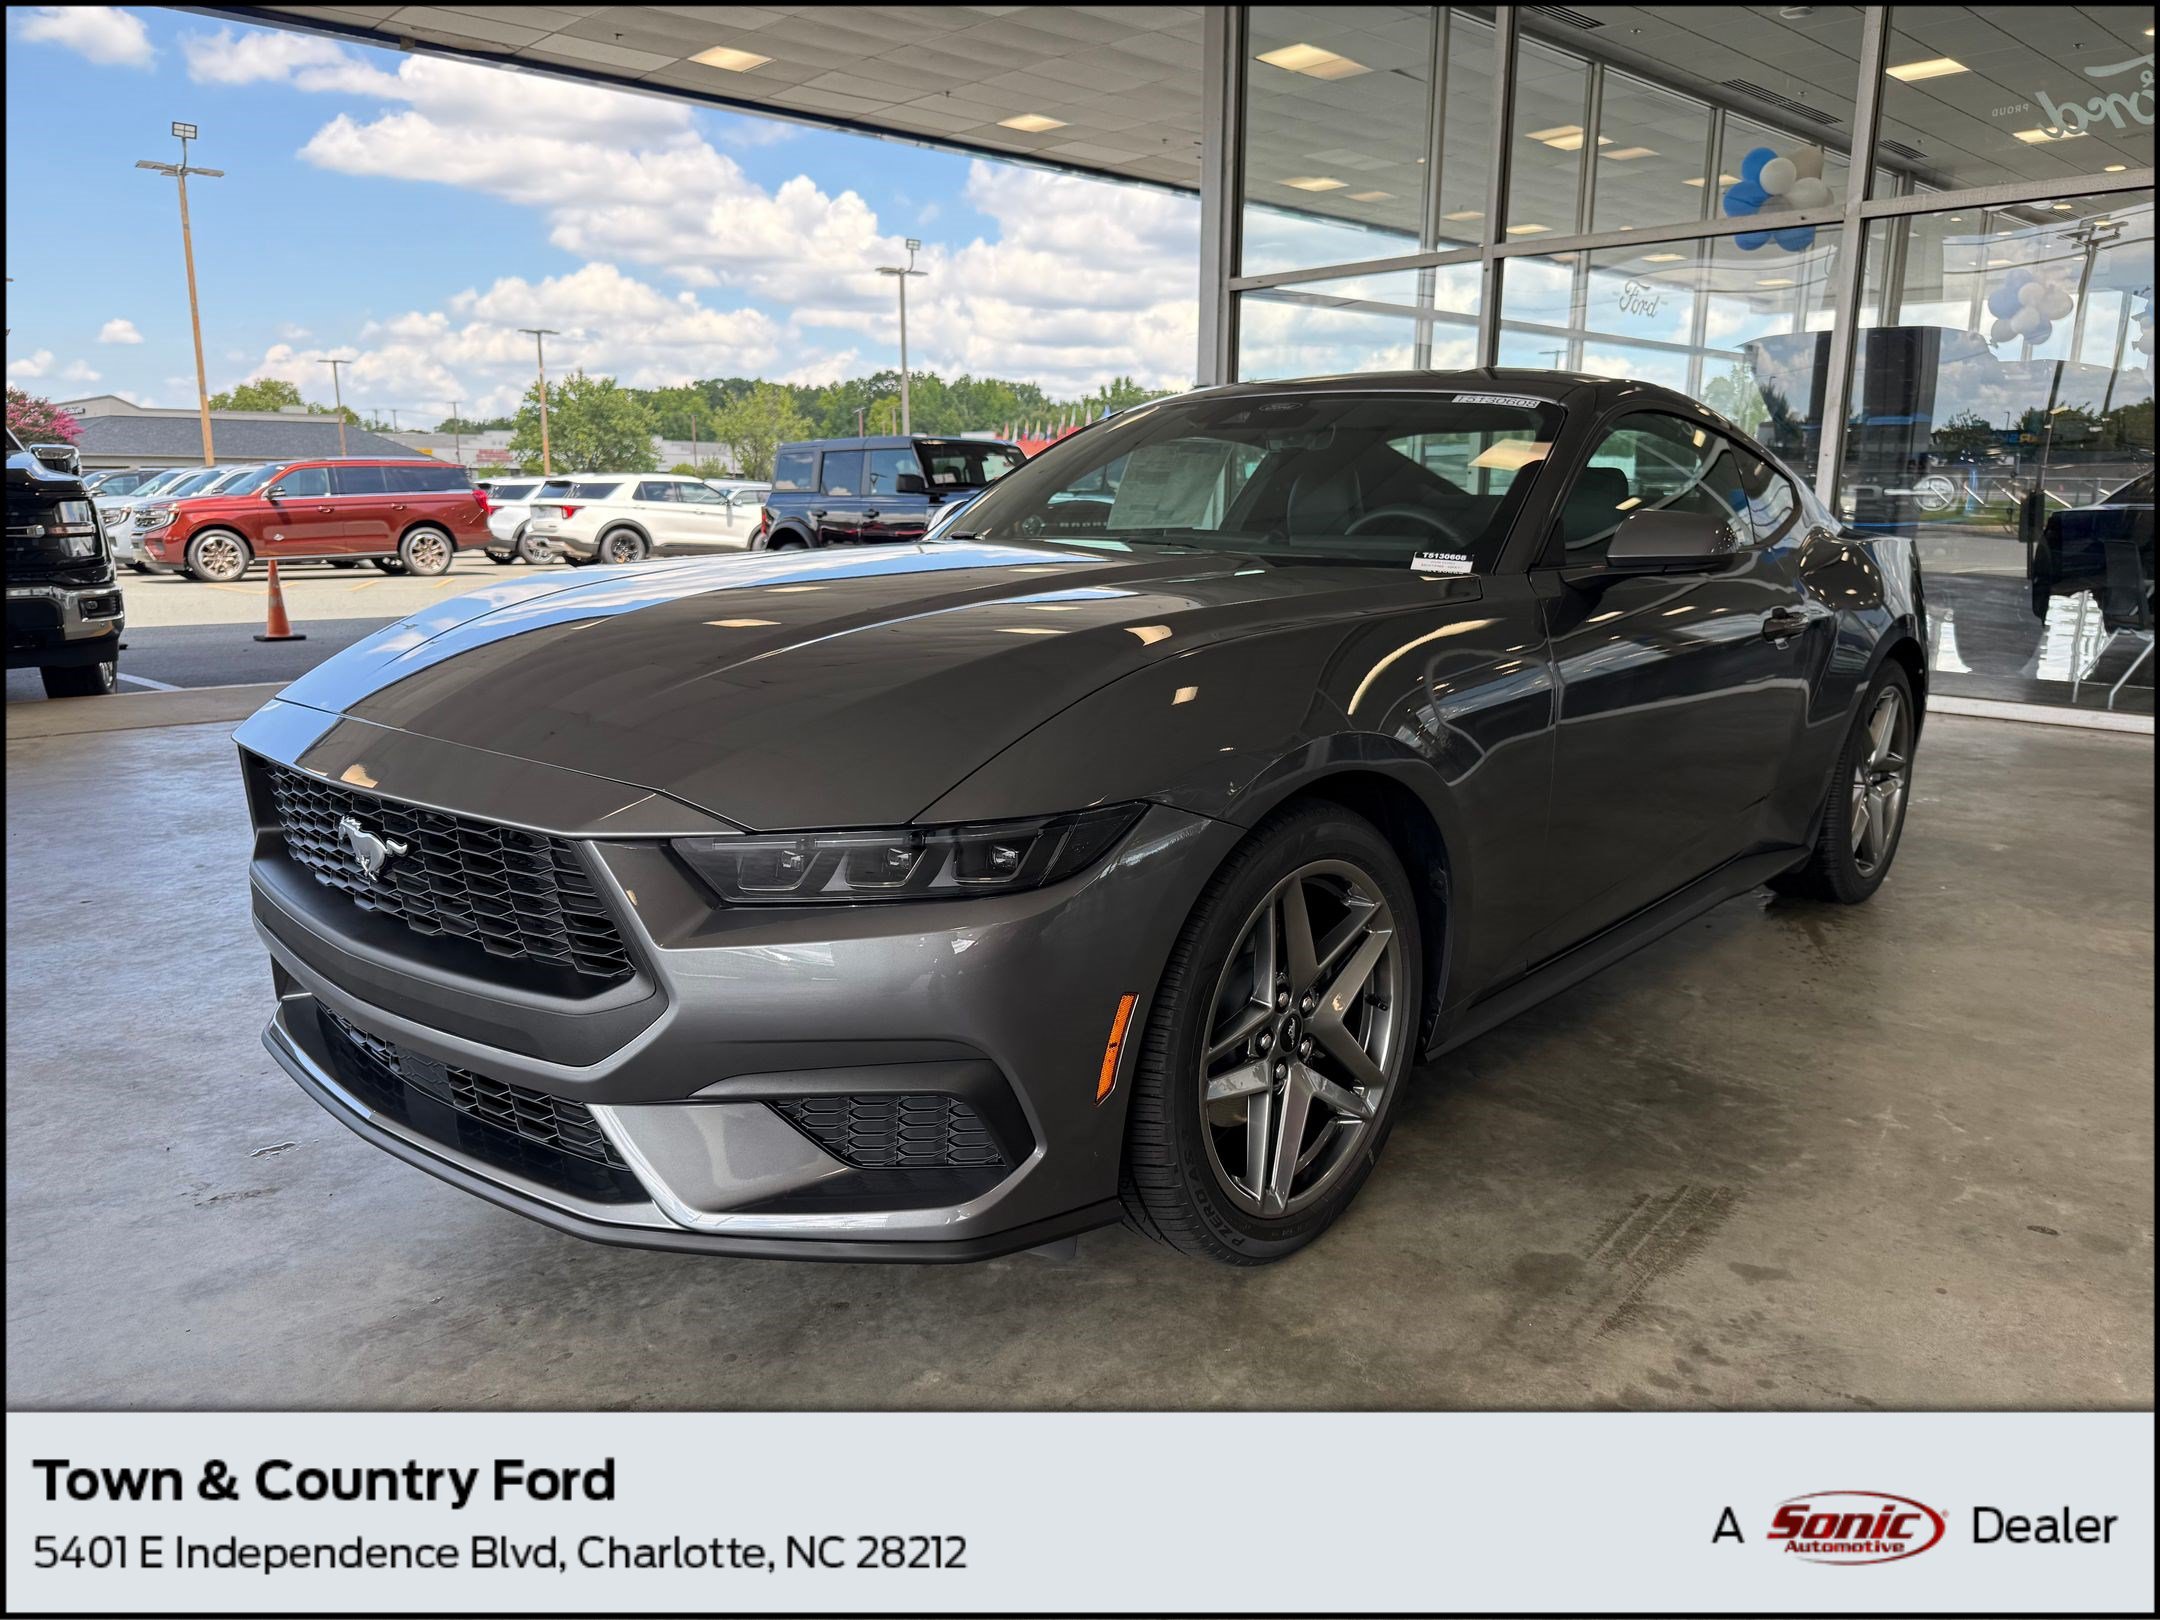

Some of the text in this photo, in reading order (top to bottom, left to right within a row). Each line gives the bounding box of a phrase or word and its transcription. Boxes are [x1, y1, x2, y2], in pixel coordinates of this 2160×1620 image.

[1619, 280, 1660, 319] Ford
[1422, 552, 1467, 561] T5130608
[1194, 1188, 1234, 1239] ZERO
[1231, 1237, 1246, 1247] P
